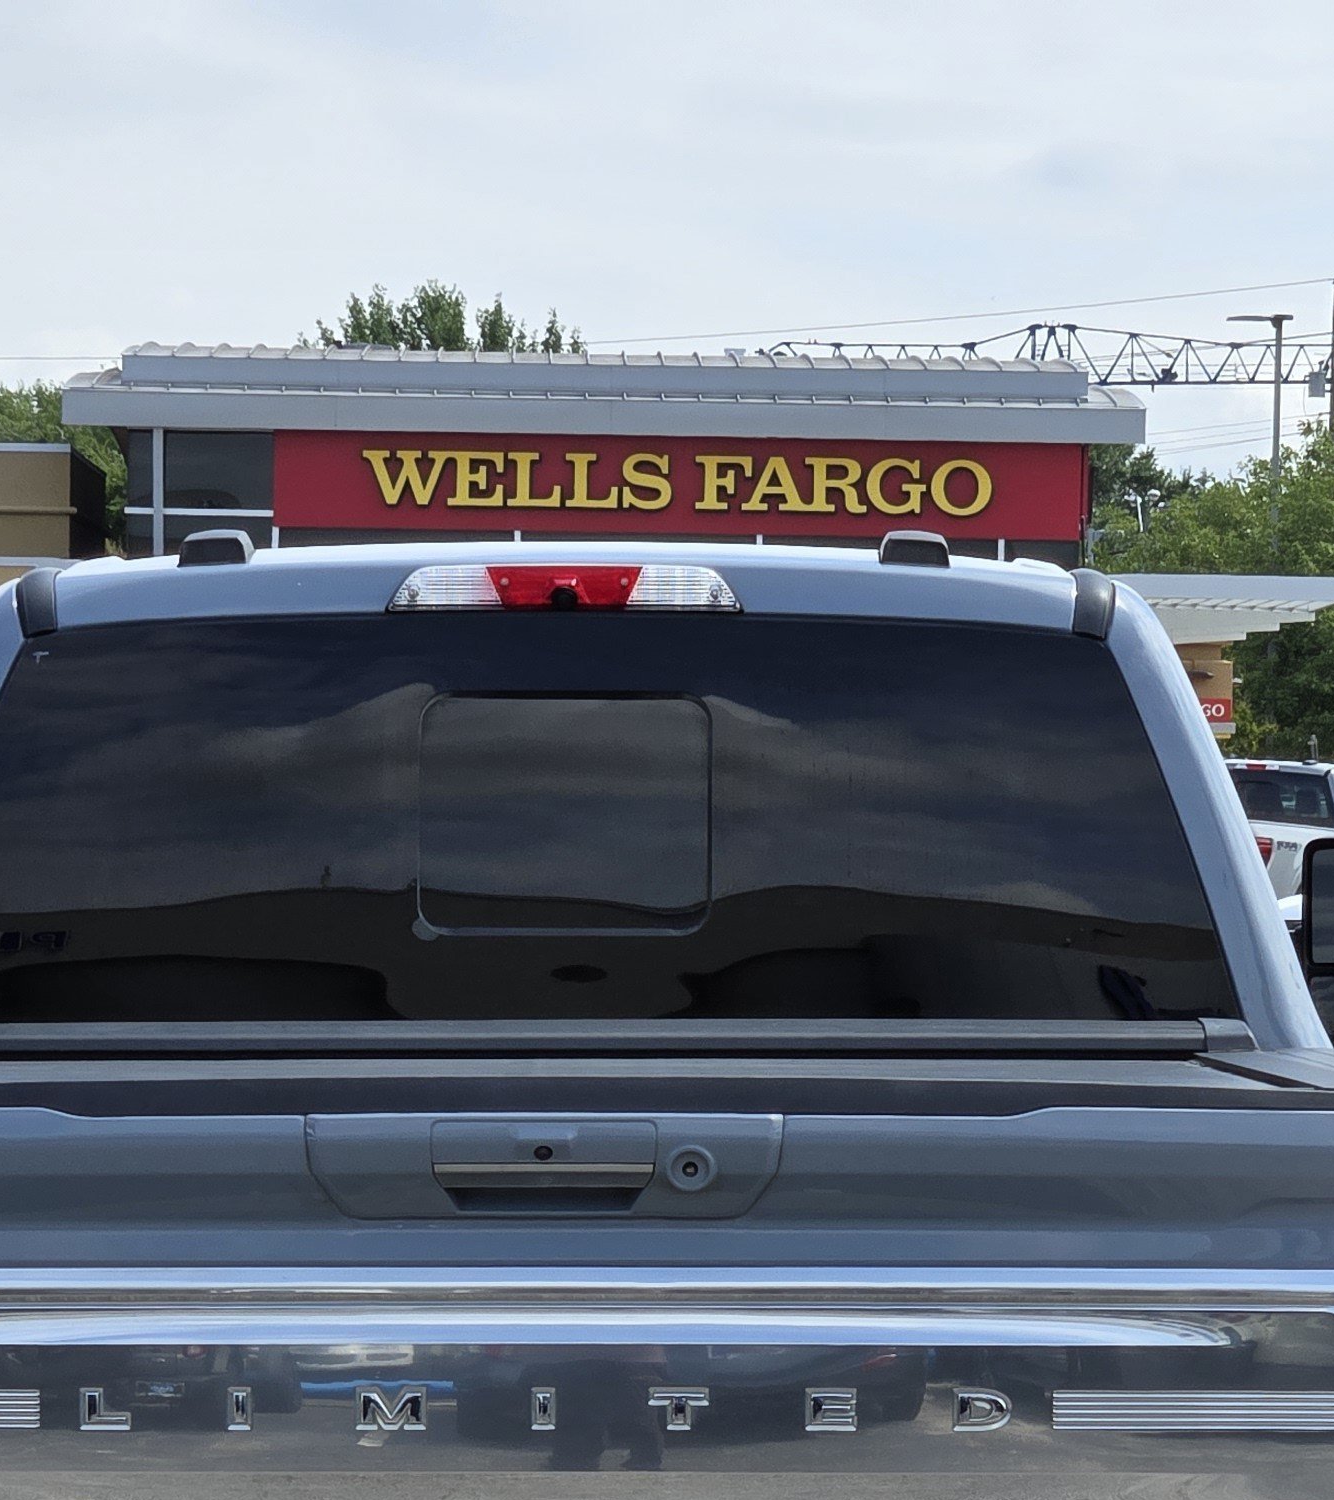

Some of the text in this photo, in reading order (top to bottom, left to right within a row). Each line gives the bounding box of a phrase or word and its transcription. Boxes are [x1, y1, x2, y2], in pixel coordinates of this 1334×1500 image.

[361, 449, 994, 517] WELLS FARGO
[79, 1386, 1013, 1432] LIMITED
